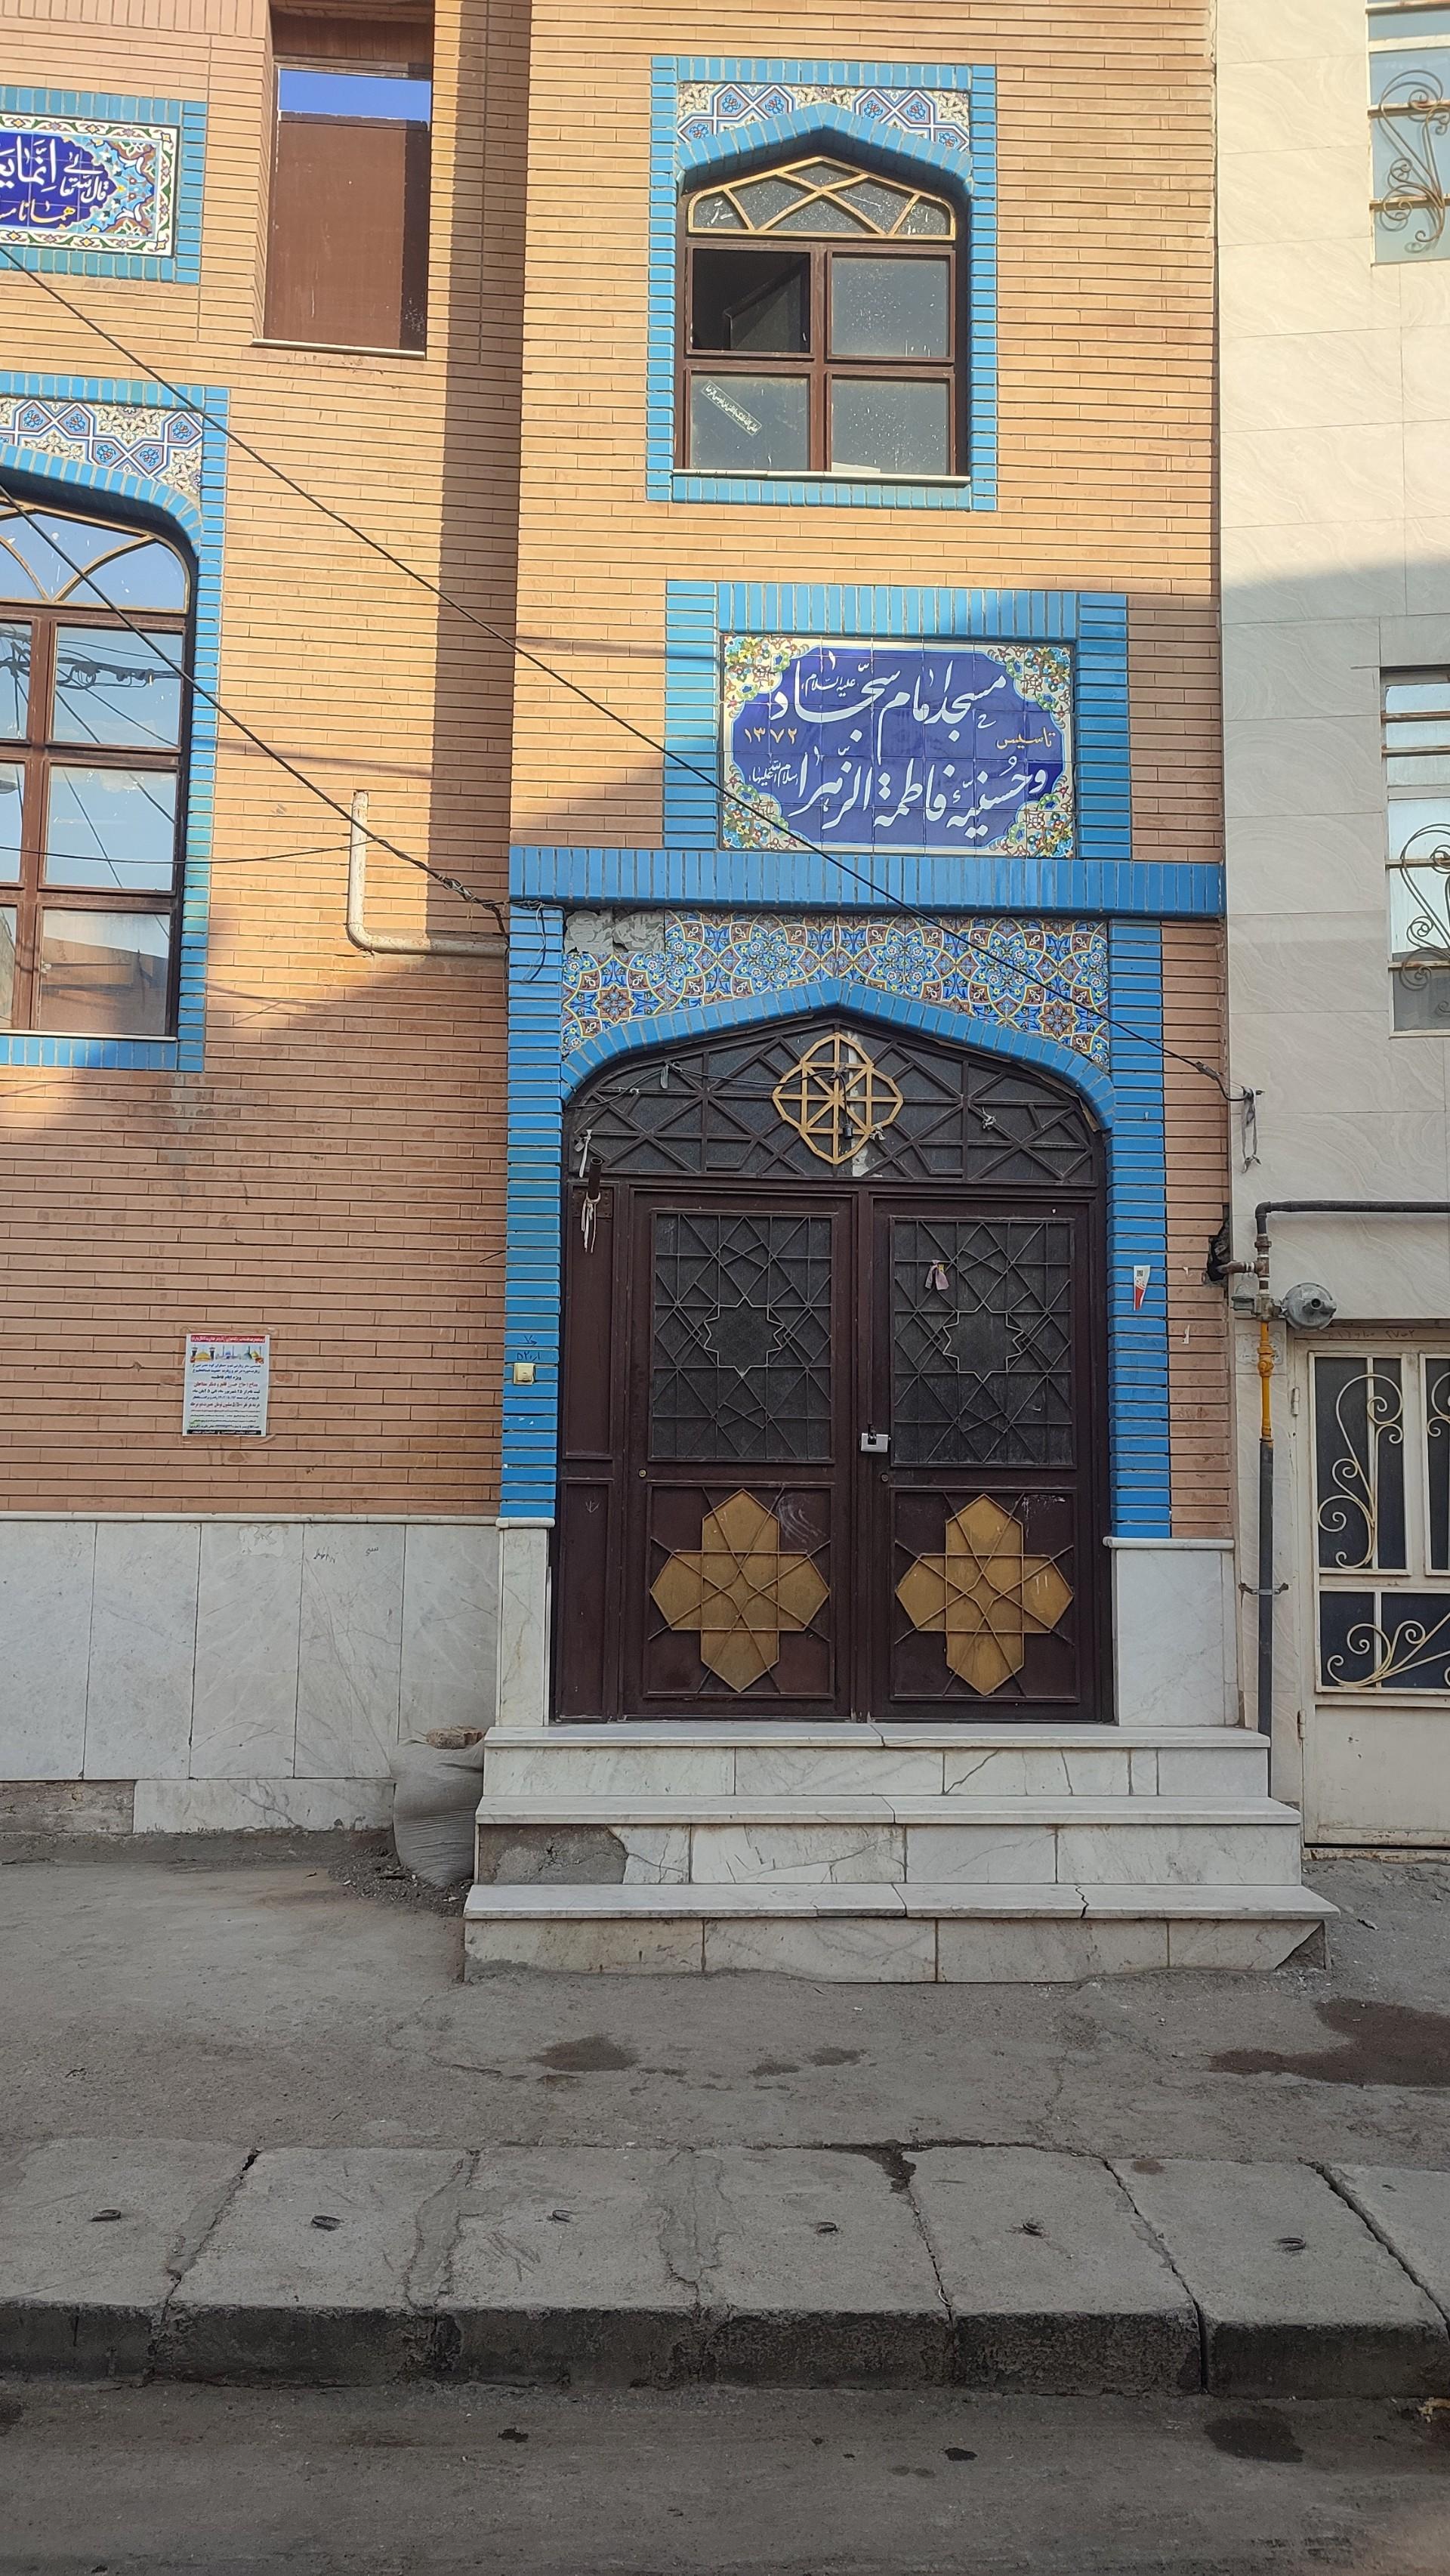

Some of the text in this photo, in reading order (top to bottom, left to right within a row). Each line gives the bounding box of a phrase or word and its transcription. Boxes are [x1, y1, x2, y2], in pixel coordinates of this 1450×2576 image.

[744, 726, 1056, 750] تاسیس ۱۳۷۲
[876, 659, 954, 767] امام
[923, 675, 1007, 743] مسجد
